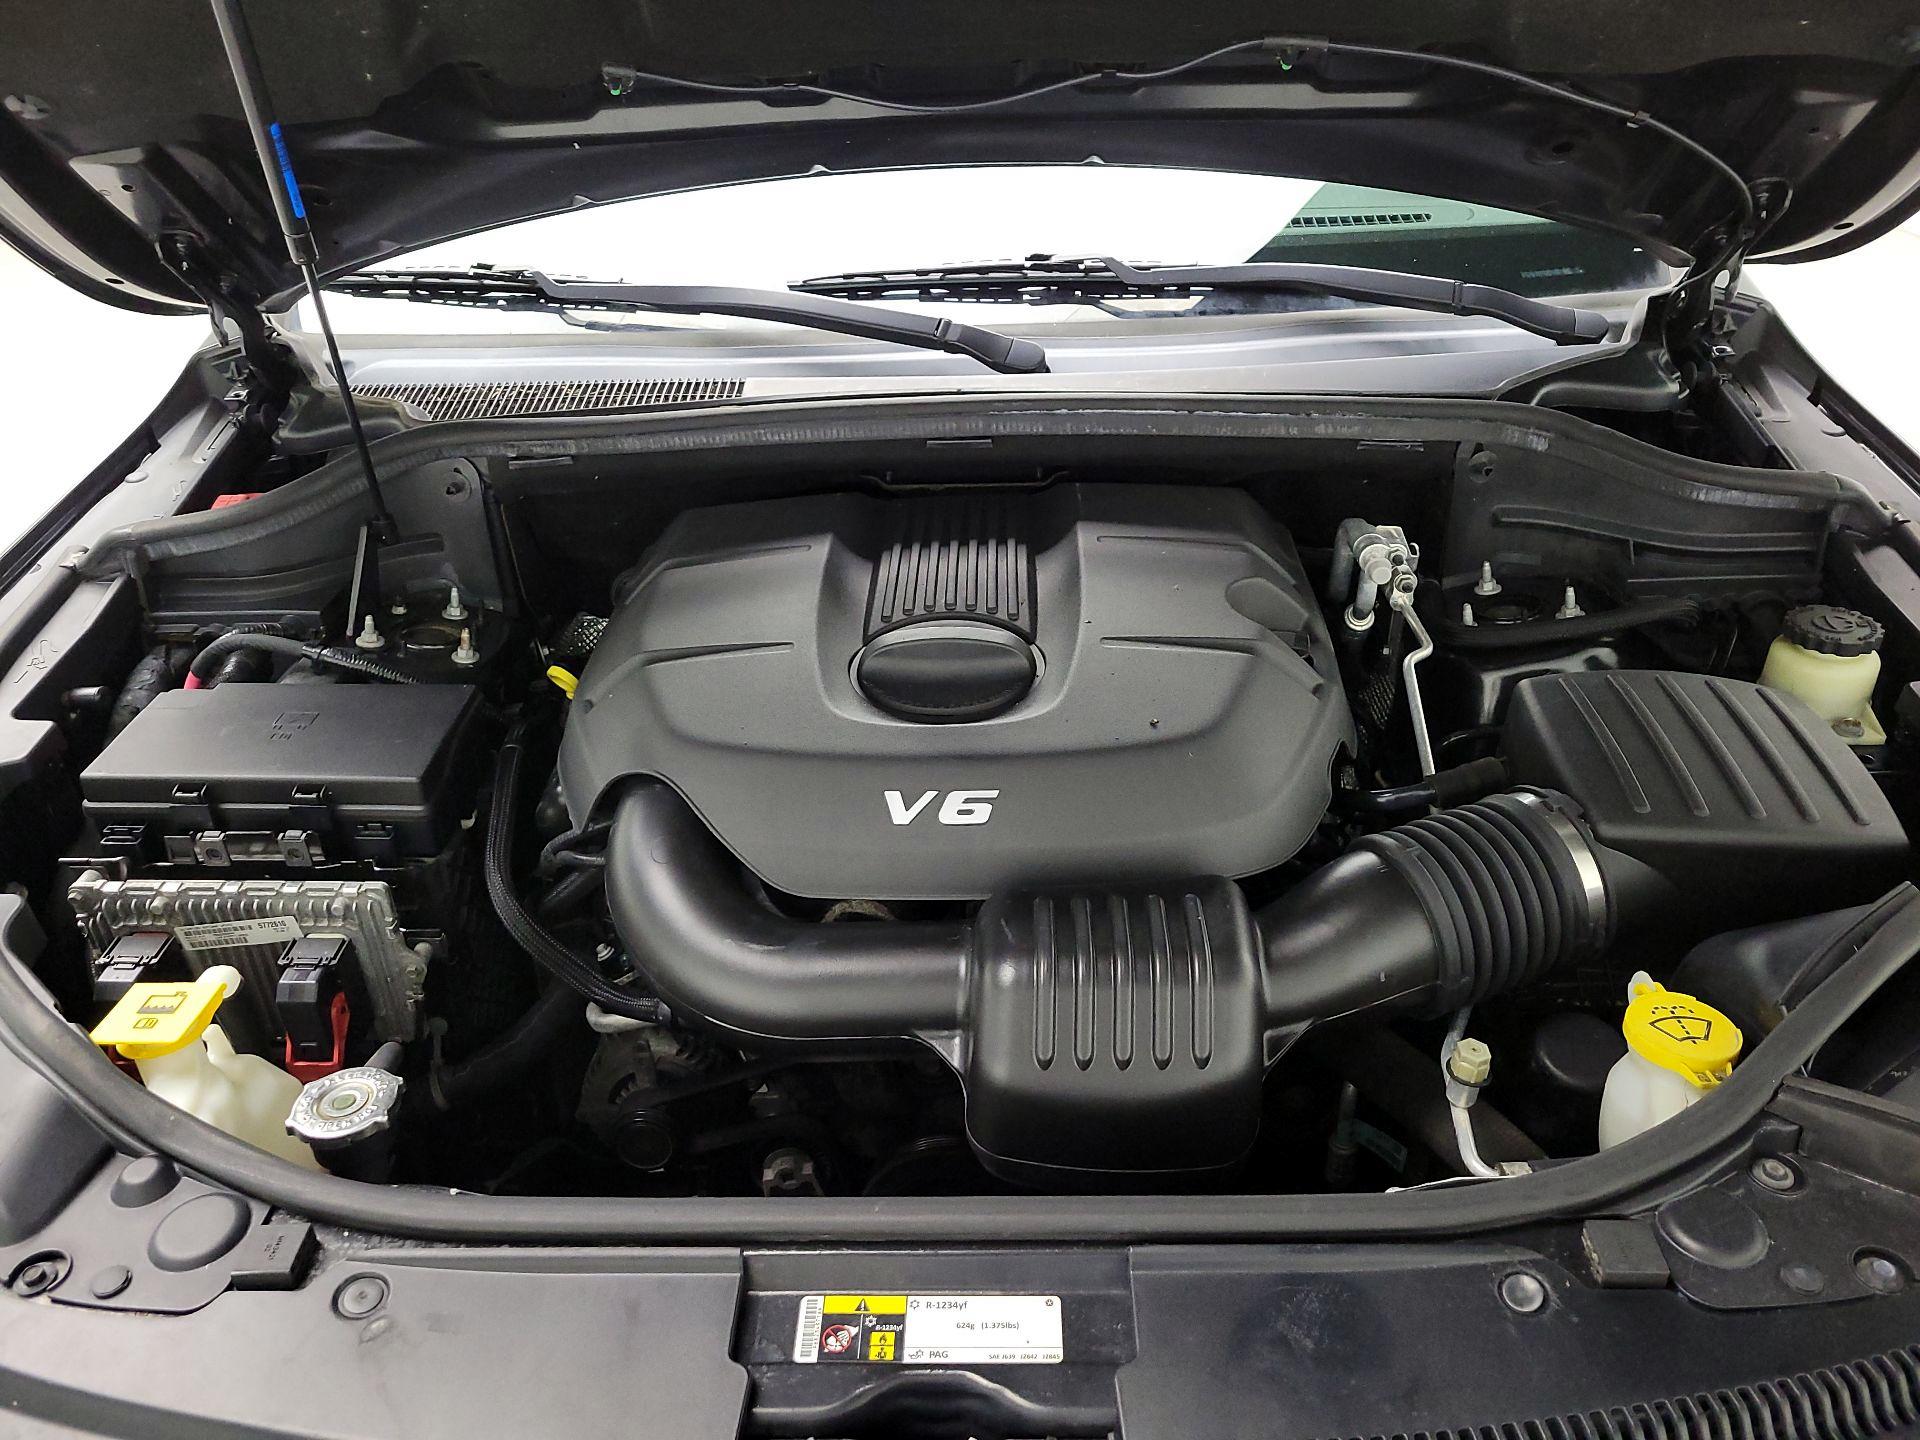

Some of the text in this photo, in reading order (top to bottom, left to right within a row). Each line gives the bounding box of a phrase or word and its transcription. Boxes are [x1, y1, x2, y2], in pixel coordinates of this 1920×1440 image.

[884, 789, 1000, 825] V6
[926, 1300, 969, 1311] R-1234yf
[956, 1320, 1020, 1331] 624g (1.375lbs)
[929, 1350, 949, 1359] PAG
